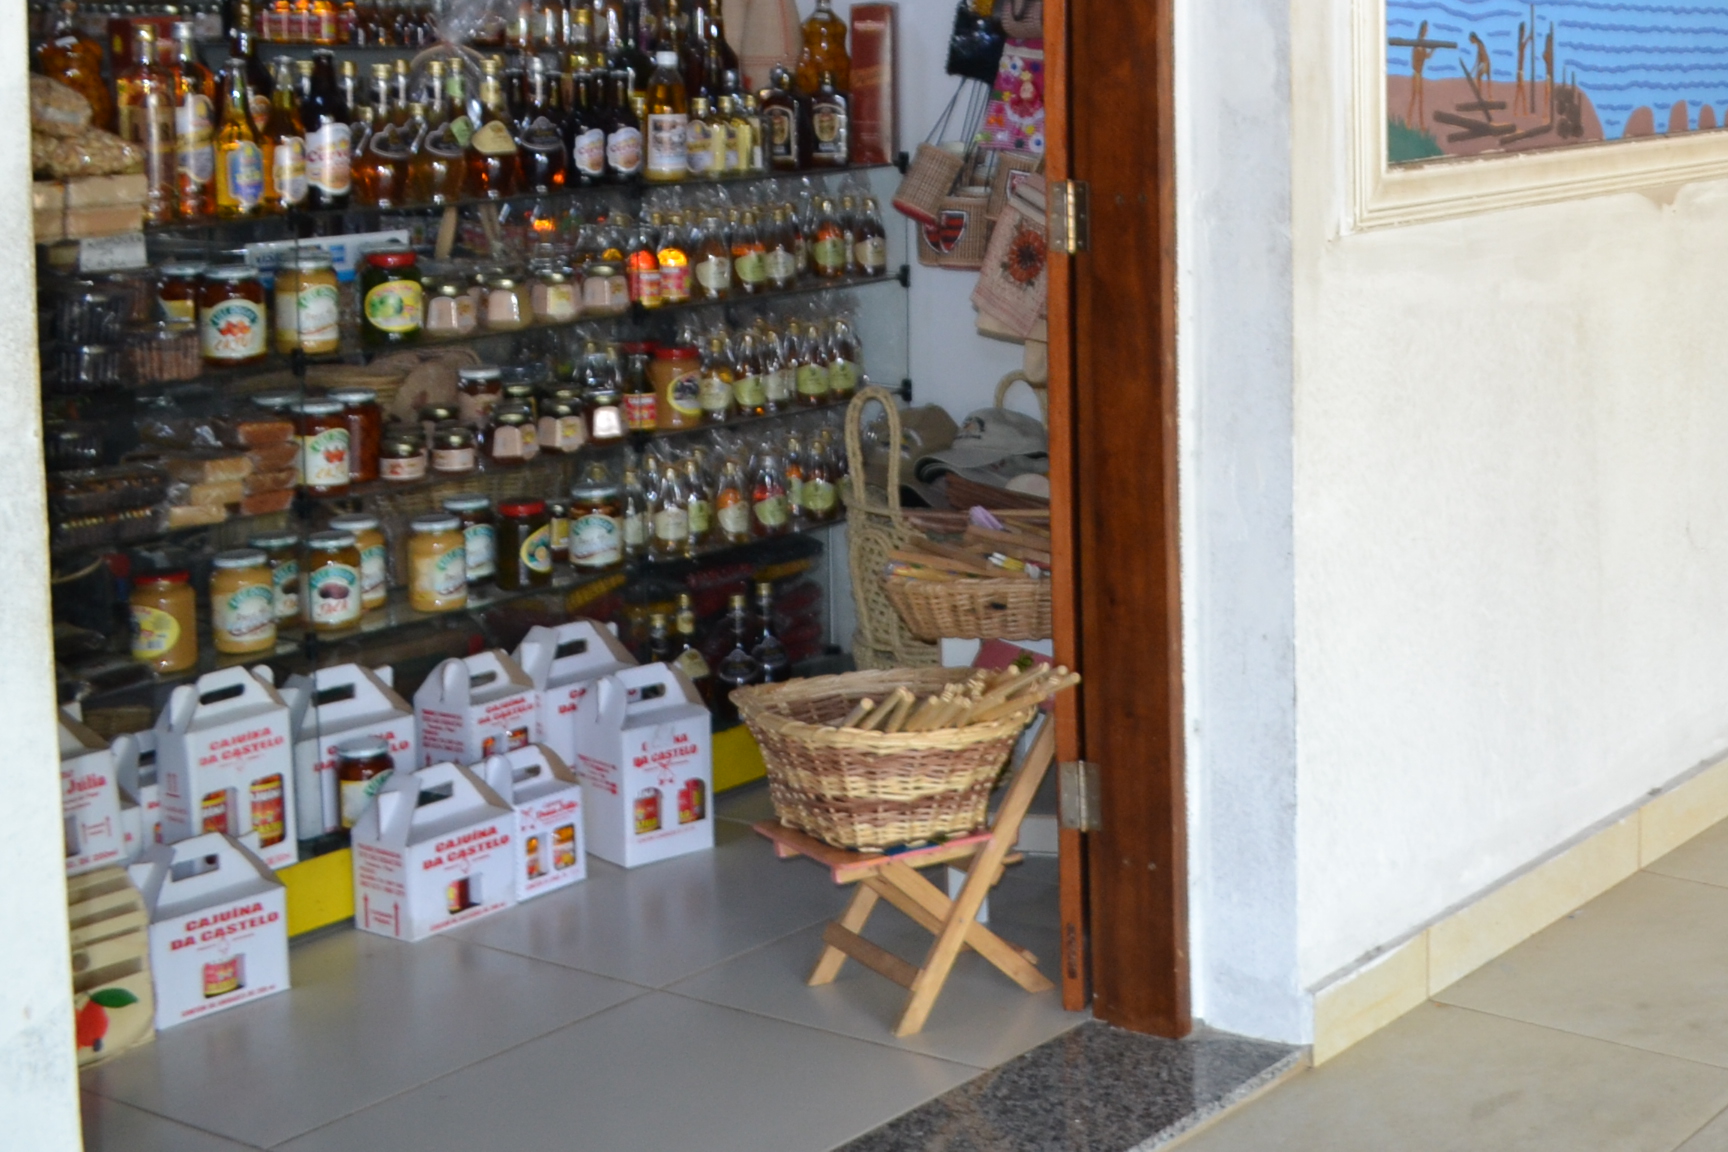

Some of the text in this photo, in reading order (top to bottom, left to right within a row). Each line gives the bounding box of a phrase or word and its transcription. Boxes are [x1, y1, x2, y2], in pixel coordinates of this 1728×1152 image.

[422, 835, 511, 870] DA CASTELO
[169, 911, 280, 951] DA CASTELO
